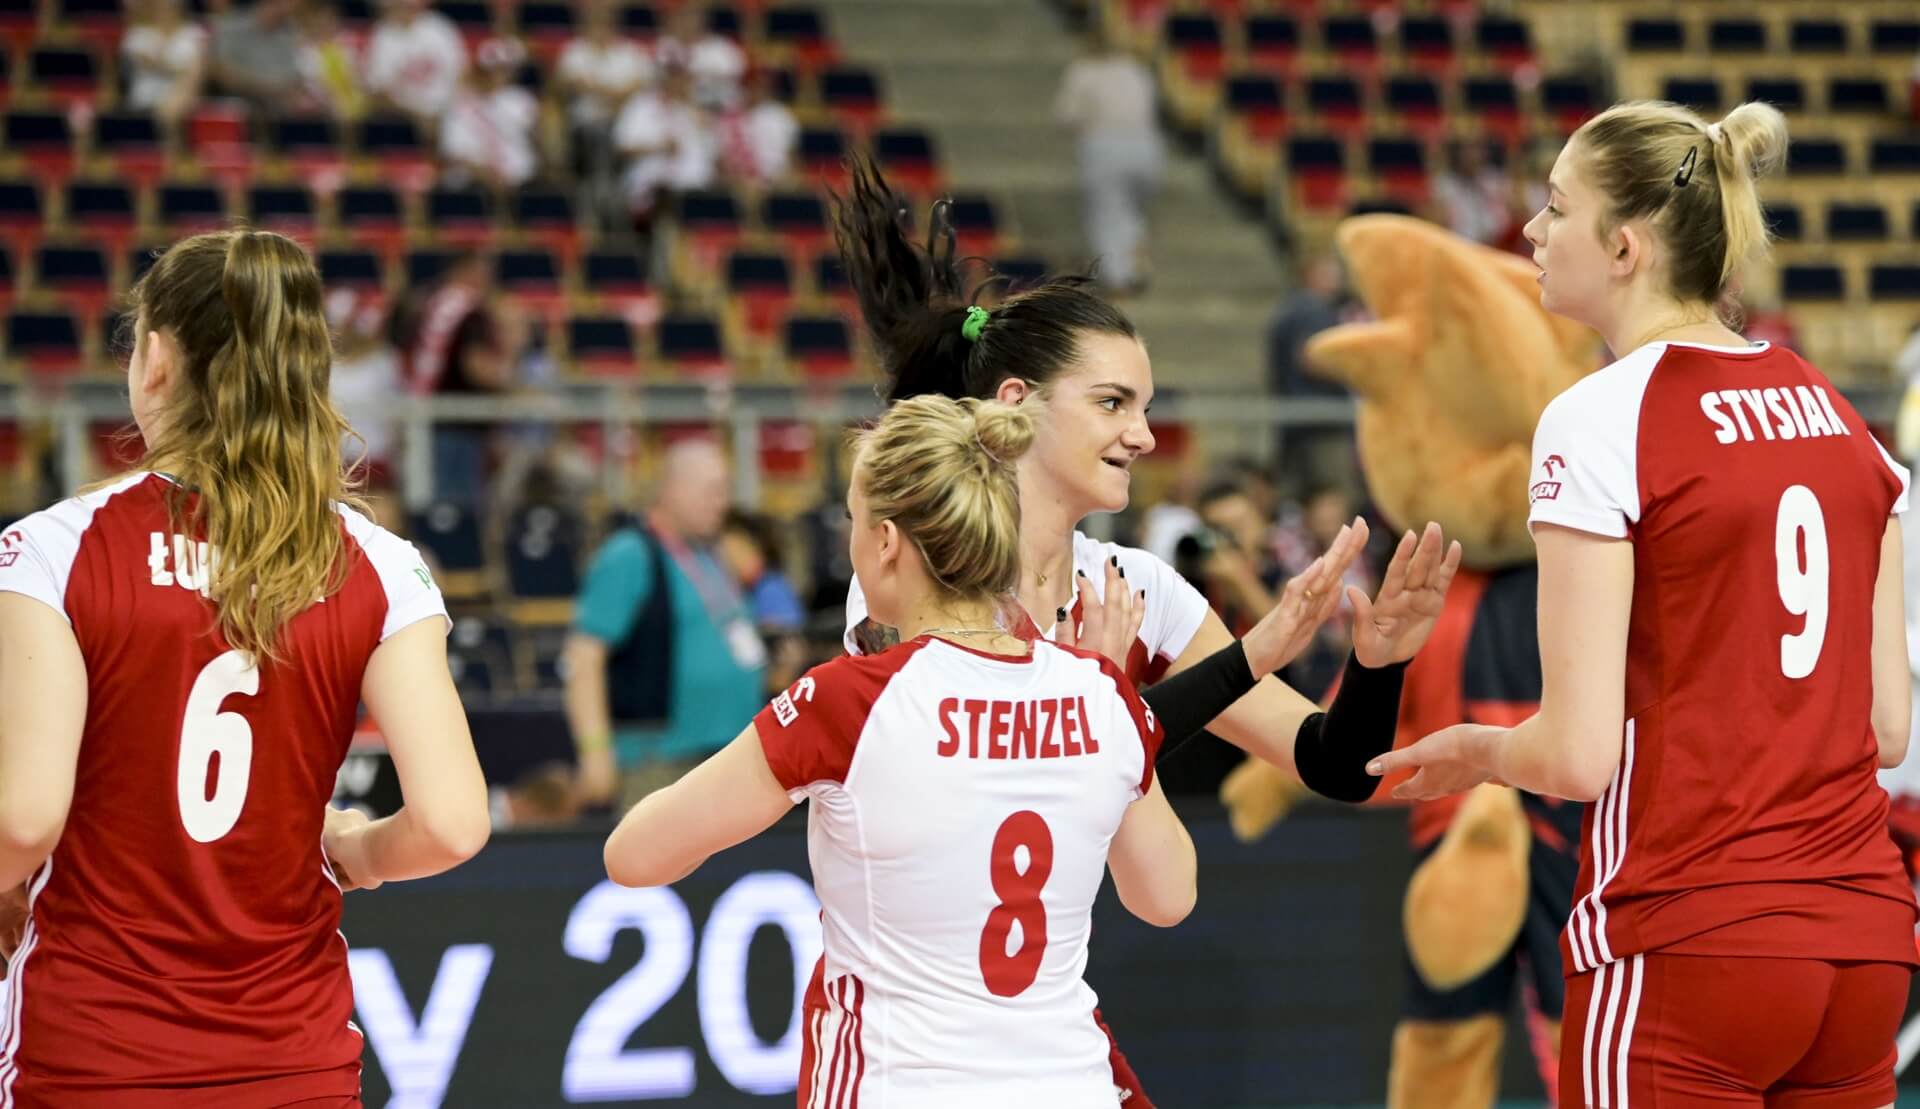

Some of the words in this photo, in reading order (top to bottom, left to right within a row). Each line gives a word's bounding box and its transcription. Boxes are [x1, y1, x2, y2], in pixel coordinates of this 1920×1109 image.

[1700, 385, 1851, 444] STYSIAK
[1775, 485, 1829, 678] 9
[178, 649, 260, 842] 6
[937, 696, 1099, 759] STENZEL
[561, 869, 822, 1102] 20
[979, 810, 1053, 997] 8
